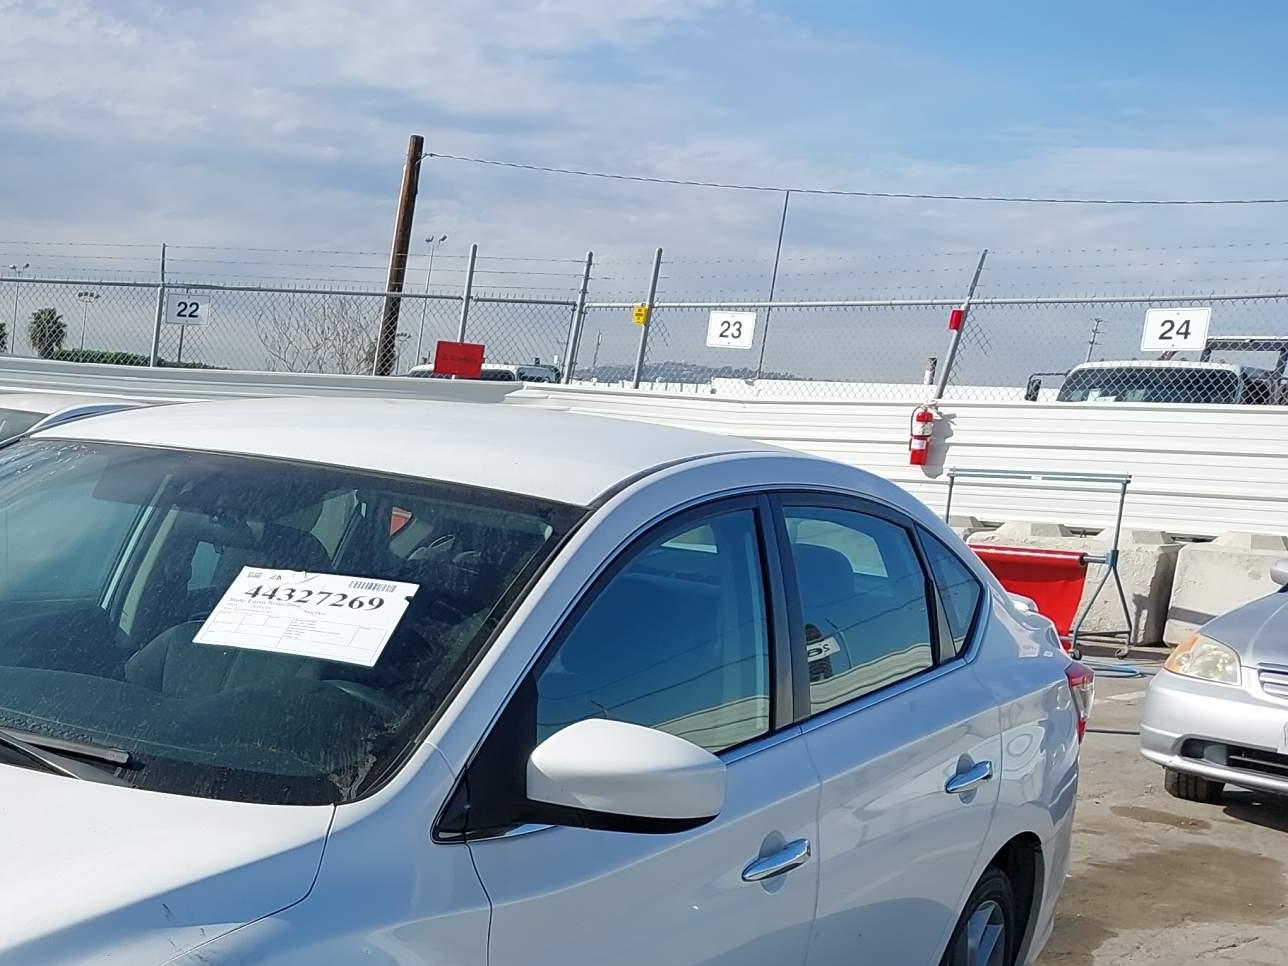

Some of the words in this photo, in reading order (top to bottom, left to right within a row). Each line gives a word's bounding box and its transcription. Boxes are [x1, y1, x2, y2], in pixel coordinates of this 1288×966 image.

[176, 301, 199, 318] 22
[719, 321, 743, 339] 23
[1158, 319, 1192, 340] 24
[244, 584, 385, 612] 44327269
